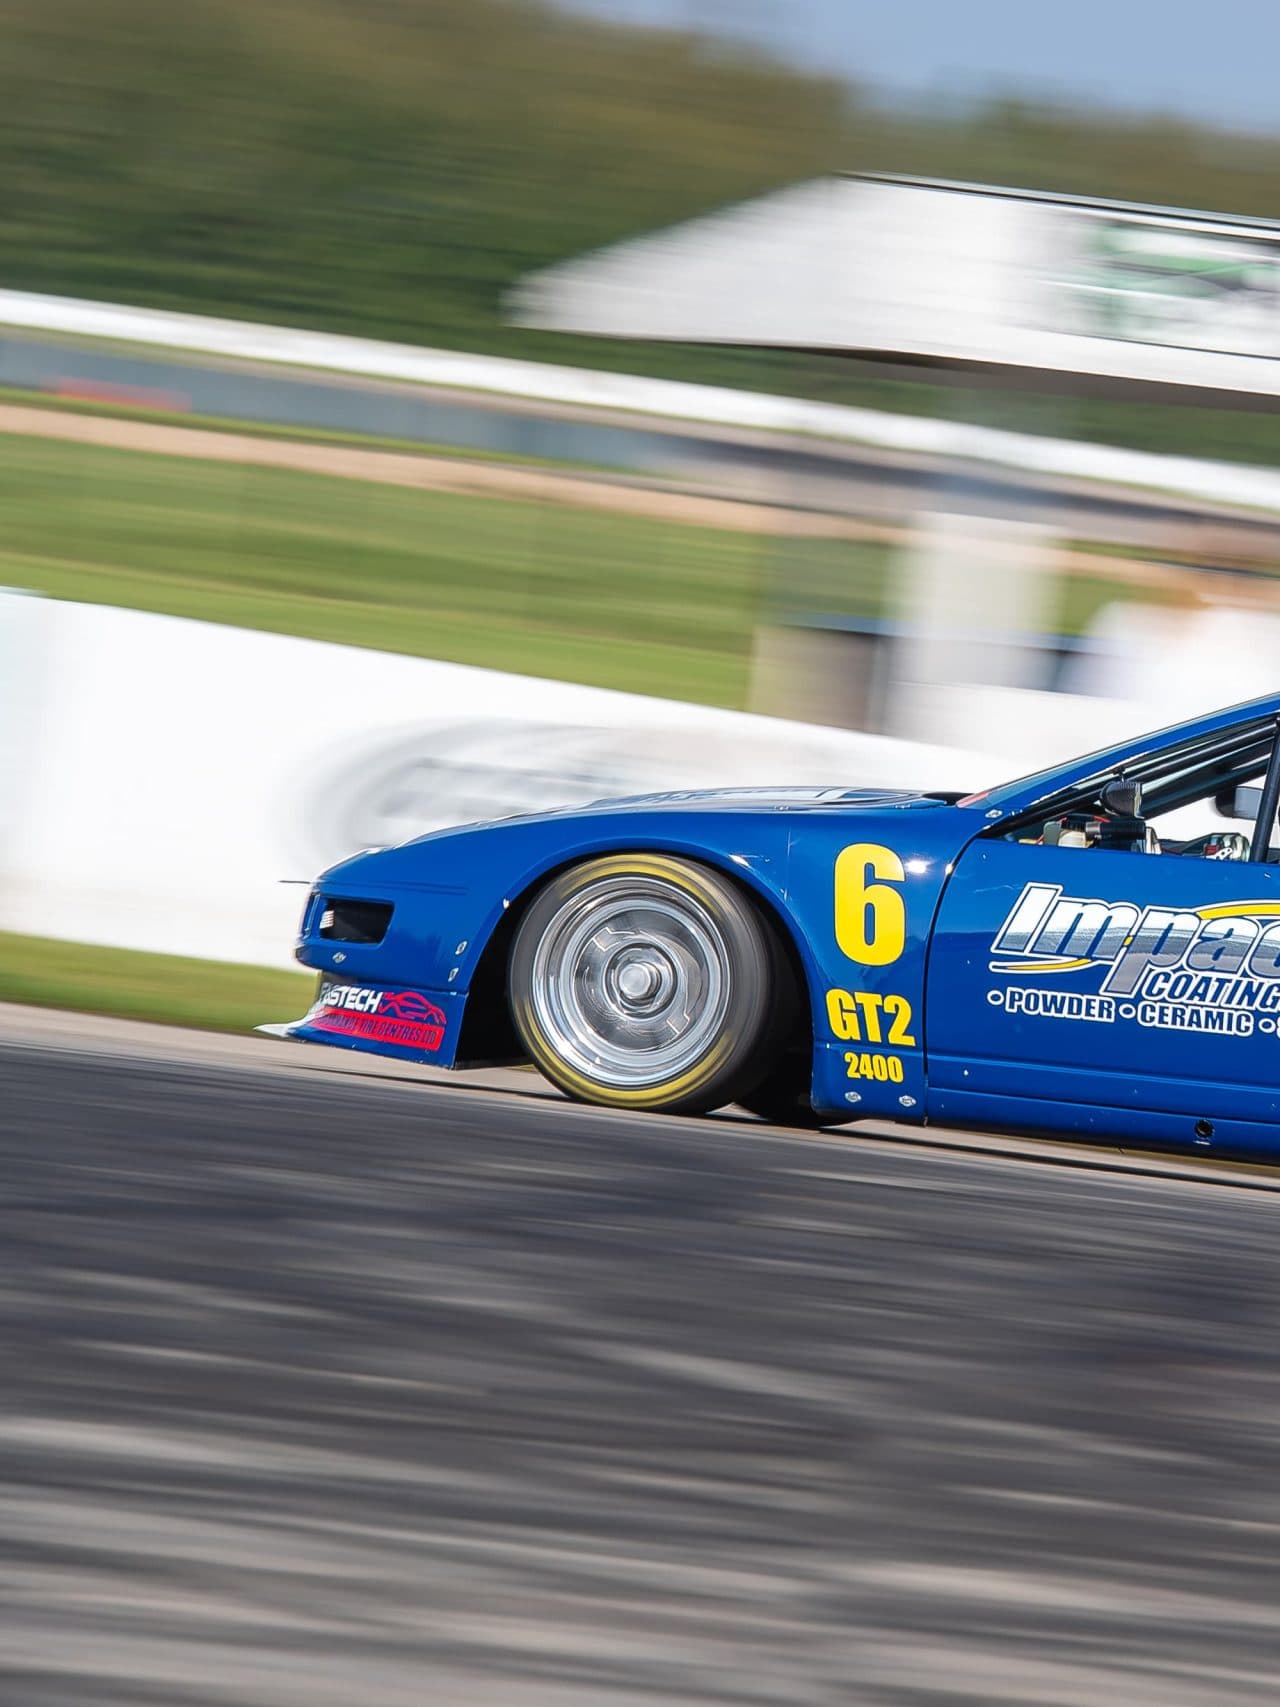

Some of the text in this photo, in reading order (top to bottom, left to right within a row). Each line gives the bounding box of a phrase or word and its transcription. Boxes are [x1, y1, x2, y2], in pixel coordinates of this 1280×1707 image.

[834, 842, 906, 966] 6
[826, 988, 916, 1047] GT2
[843, 1051, 904, 1083] 2400
